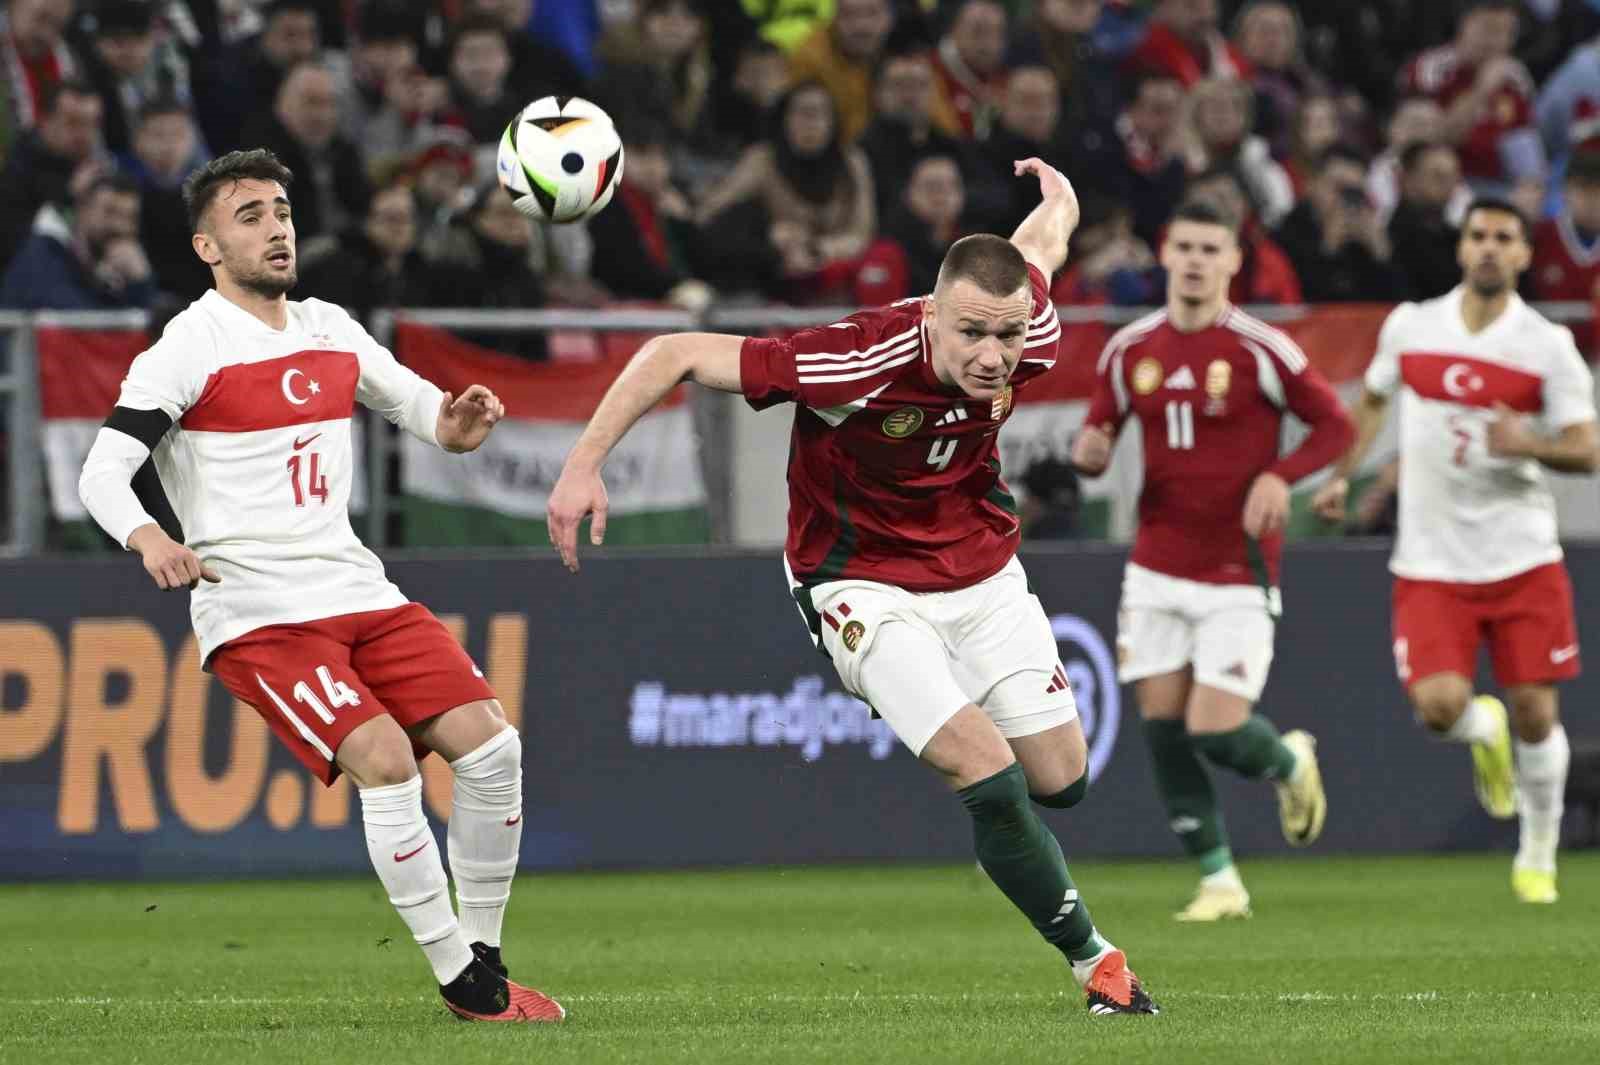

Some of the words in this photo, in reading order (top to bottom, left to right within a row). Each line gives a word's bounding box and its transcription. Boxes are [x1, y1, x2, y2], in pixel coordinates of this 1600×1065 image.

[1165, 400, 1195, 450] 11
[288, 453, 329, 507] 14
[926, 438, 959, 472] 4
[293, 665, 362, 725] 14
